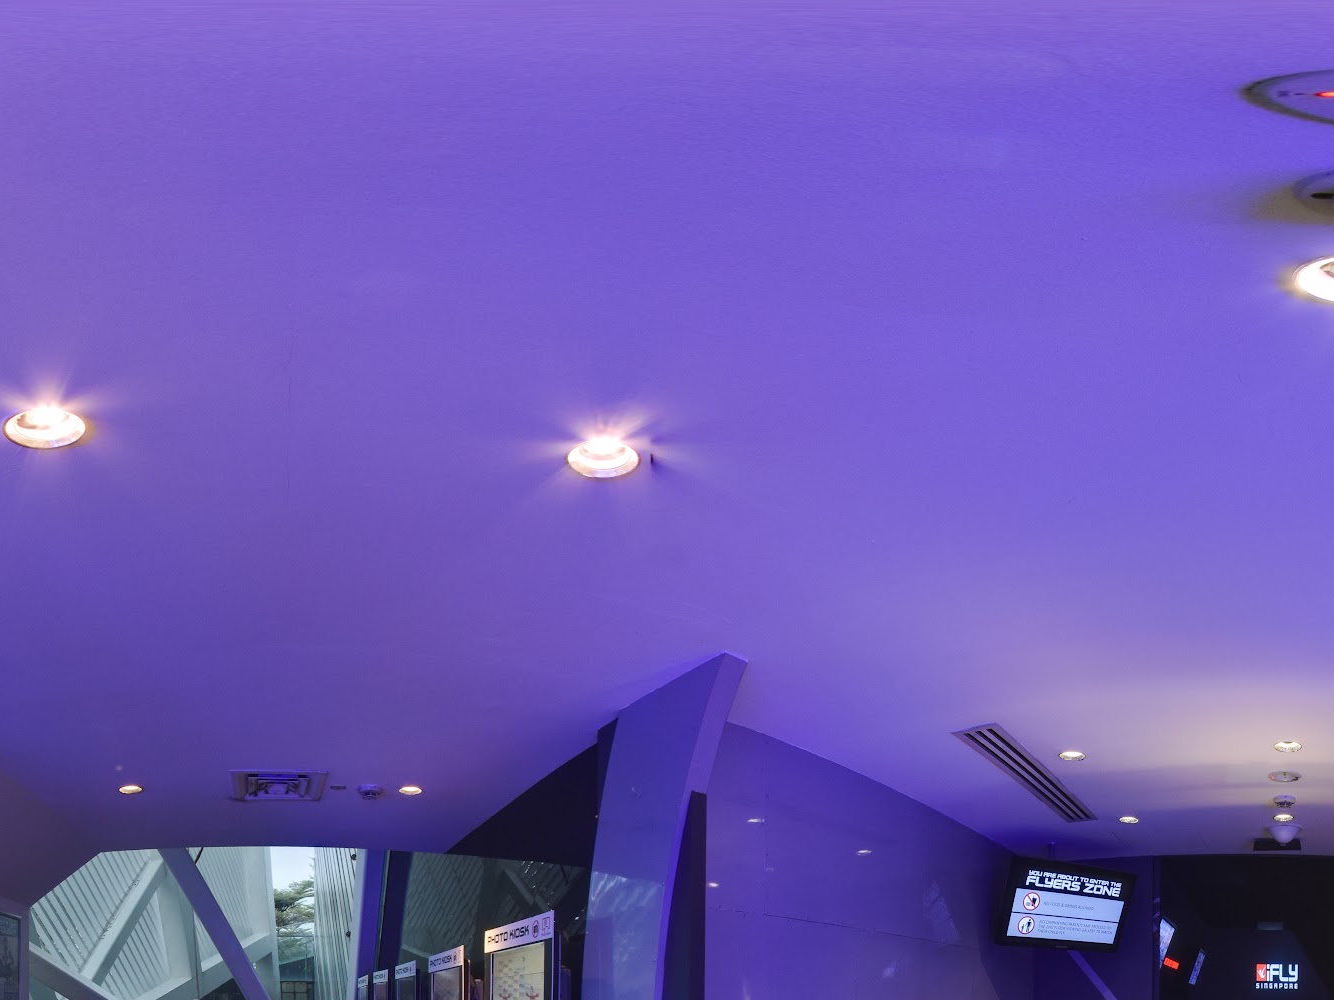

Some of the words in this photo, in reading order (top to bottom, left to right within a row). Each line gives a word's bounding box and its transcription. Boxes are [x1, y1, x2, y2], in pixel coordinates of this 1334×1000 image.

[1026, 875, 1081, 892] FLYERS
[1083, 883, 1122, 898] ZONE
[1057, 873, 1079, 881] ABOUT
[1090, 878, 1110, 886] ENTER
[487, 932, 508, 945] PHOTO
[510, 925, 530, 939] KIOSK
[429, 958, 441, 967] PHOTO
[1267, 964, 1298, 982] iFLY
